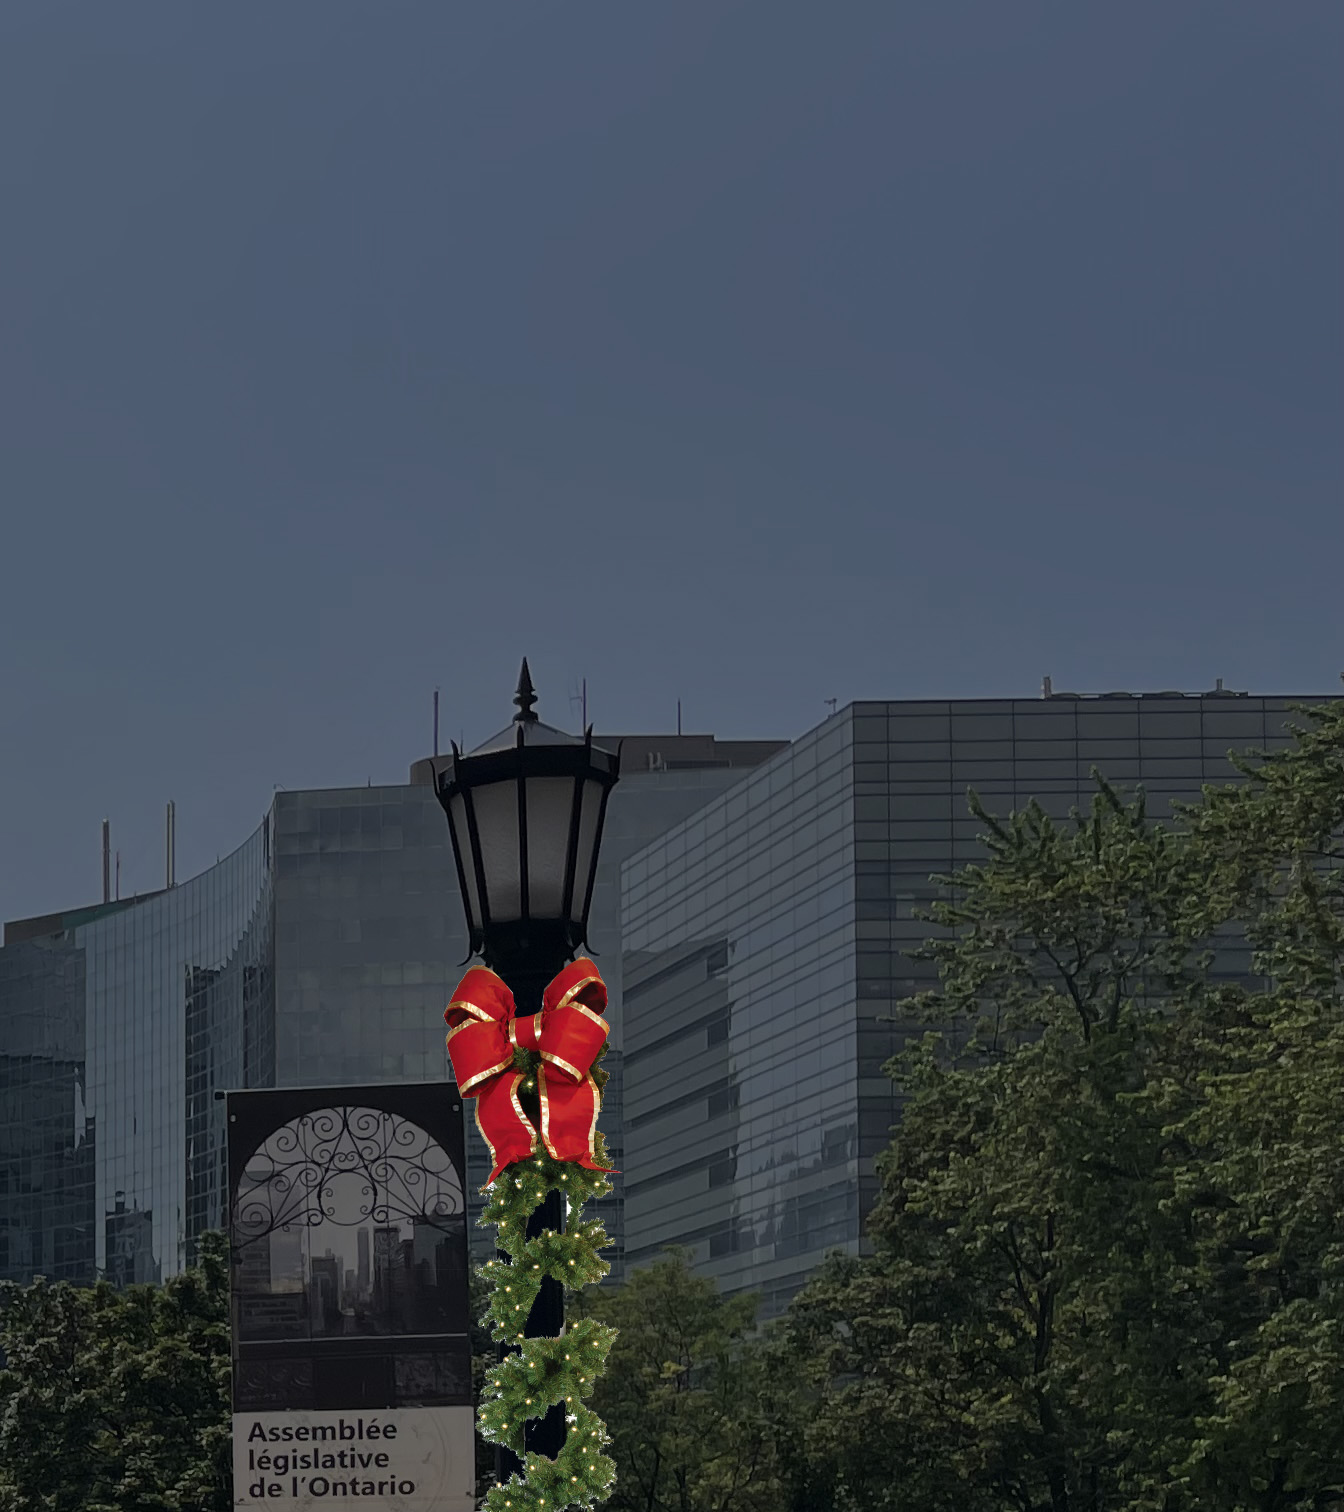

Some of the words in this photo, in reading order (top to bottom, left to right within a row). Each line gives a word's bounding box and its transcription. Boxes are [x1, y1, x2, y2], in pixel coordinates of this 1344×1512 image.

[247, 1418, 397, 1442] Assemblée
[249, 1448, 389, 1476] législative
[249, 1477, 282, 1498] de
[292, 1475, 415, 1497] l'Ontario
